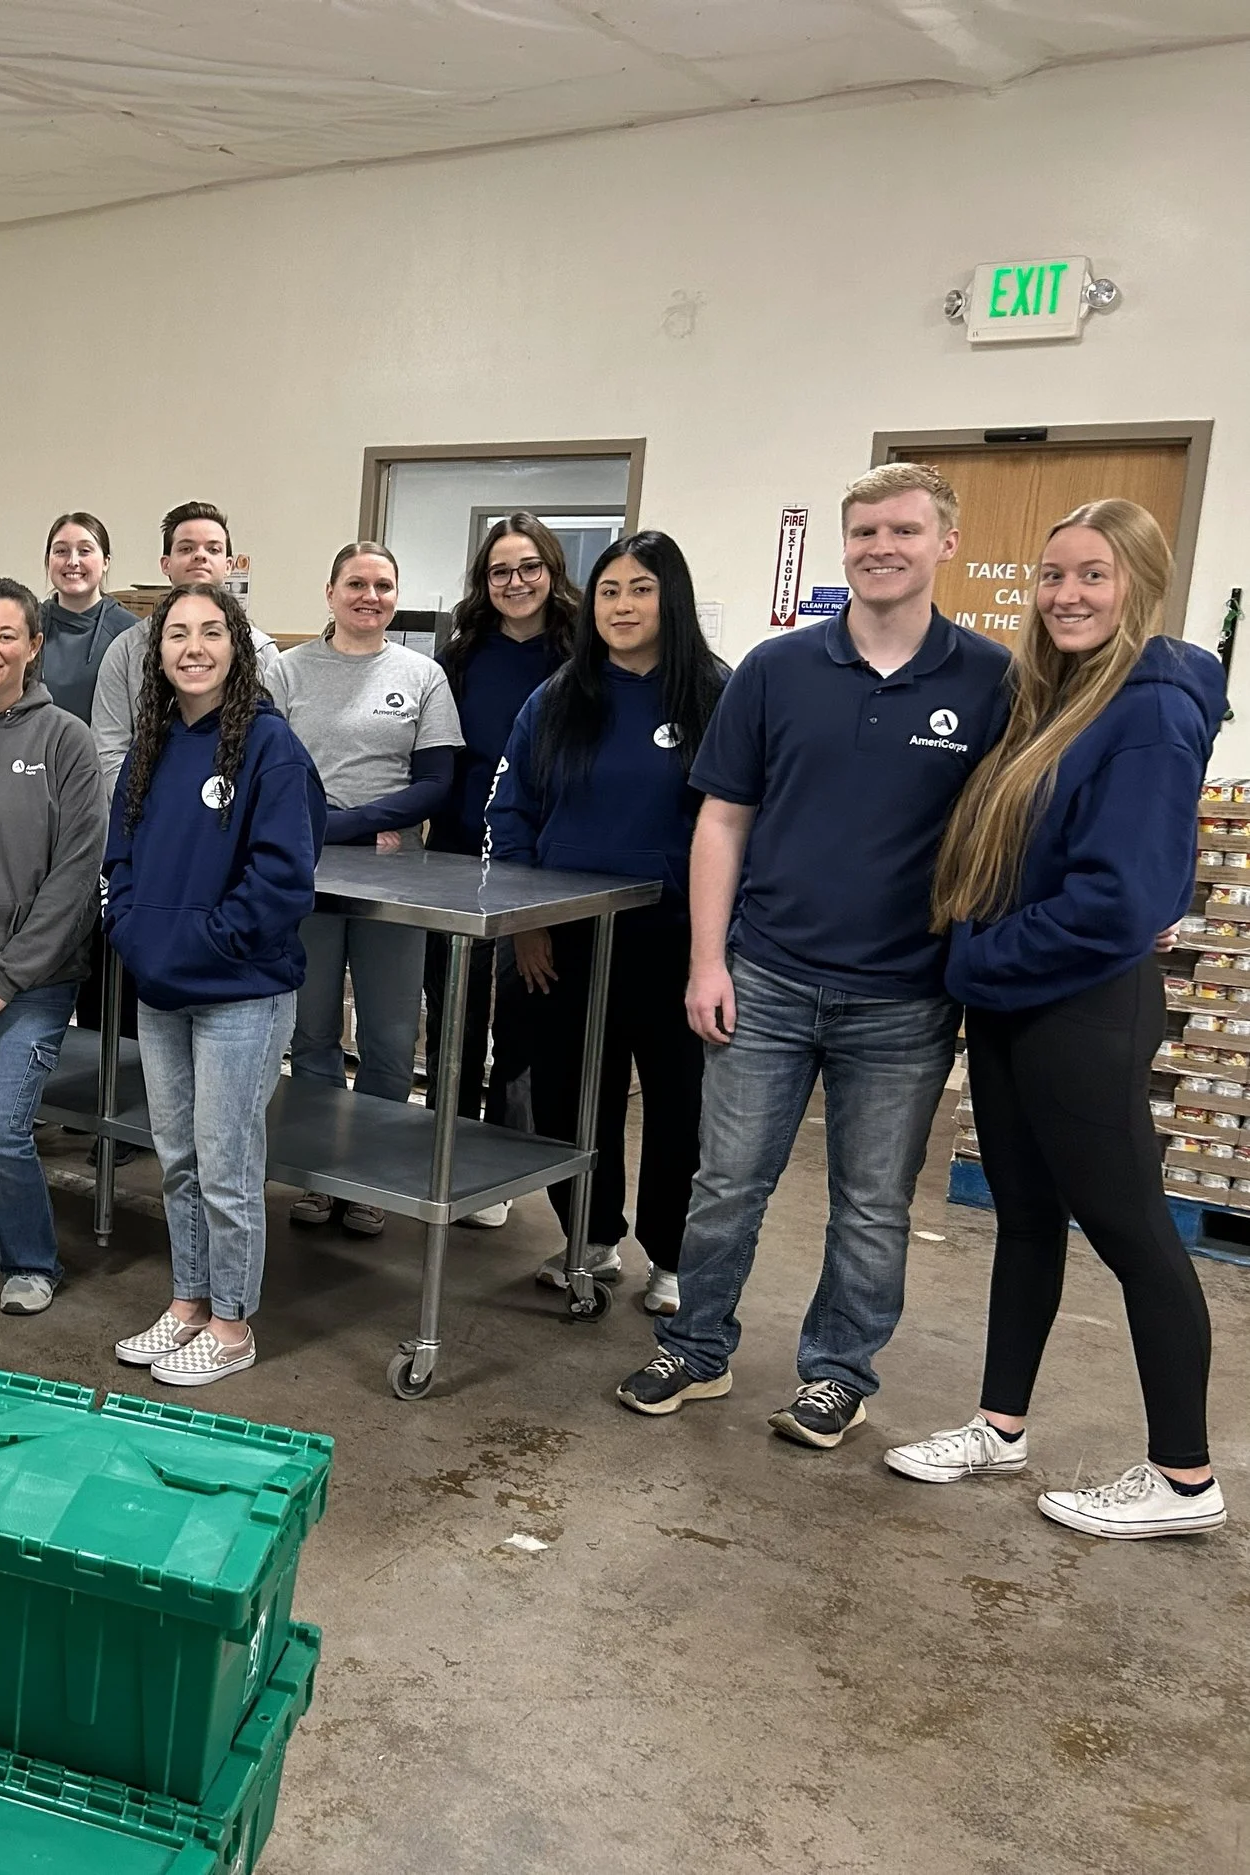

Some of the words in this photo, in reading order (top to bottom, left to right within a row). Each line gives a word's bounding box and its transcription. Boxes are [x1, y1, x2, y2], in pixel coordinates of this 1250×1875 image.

[989, 263, 1068, 318] EXIT
[783, 515, 805, 527] FIRE
[779, 528, 797, 620] EXTINGUISHER
[966, 562, 1018, 580] TAKE
[954, 612, 977, 629] IN
[981, 613, 1021, 631] THE
[909, 735, 968, 753] AmeriCorps
